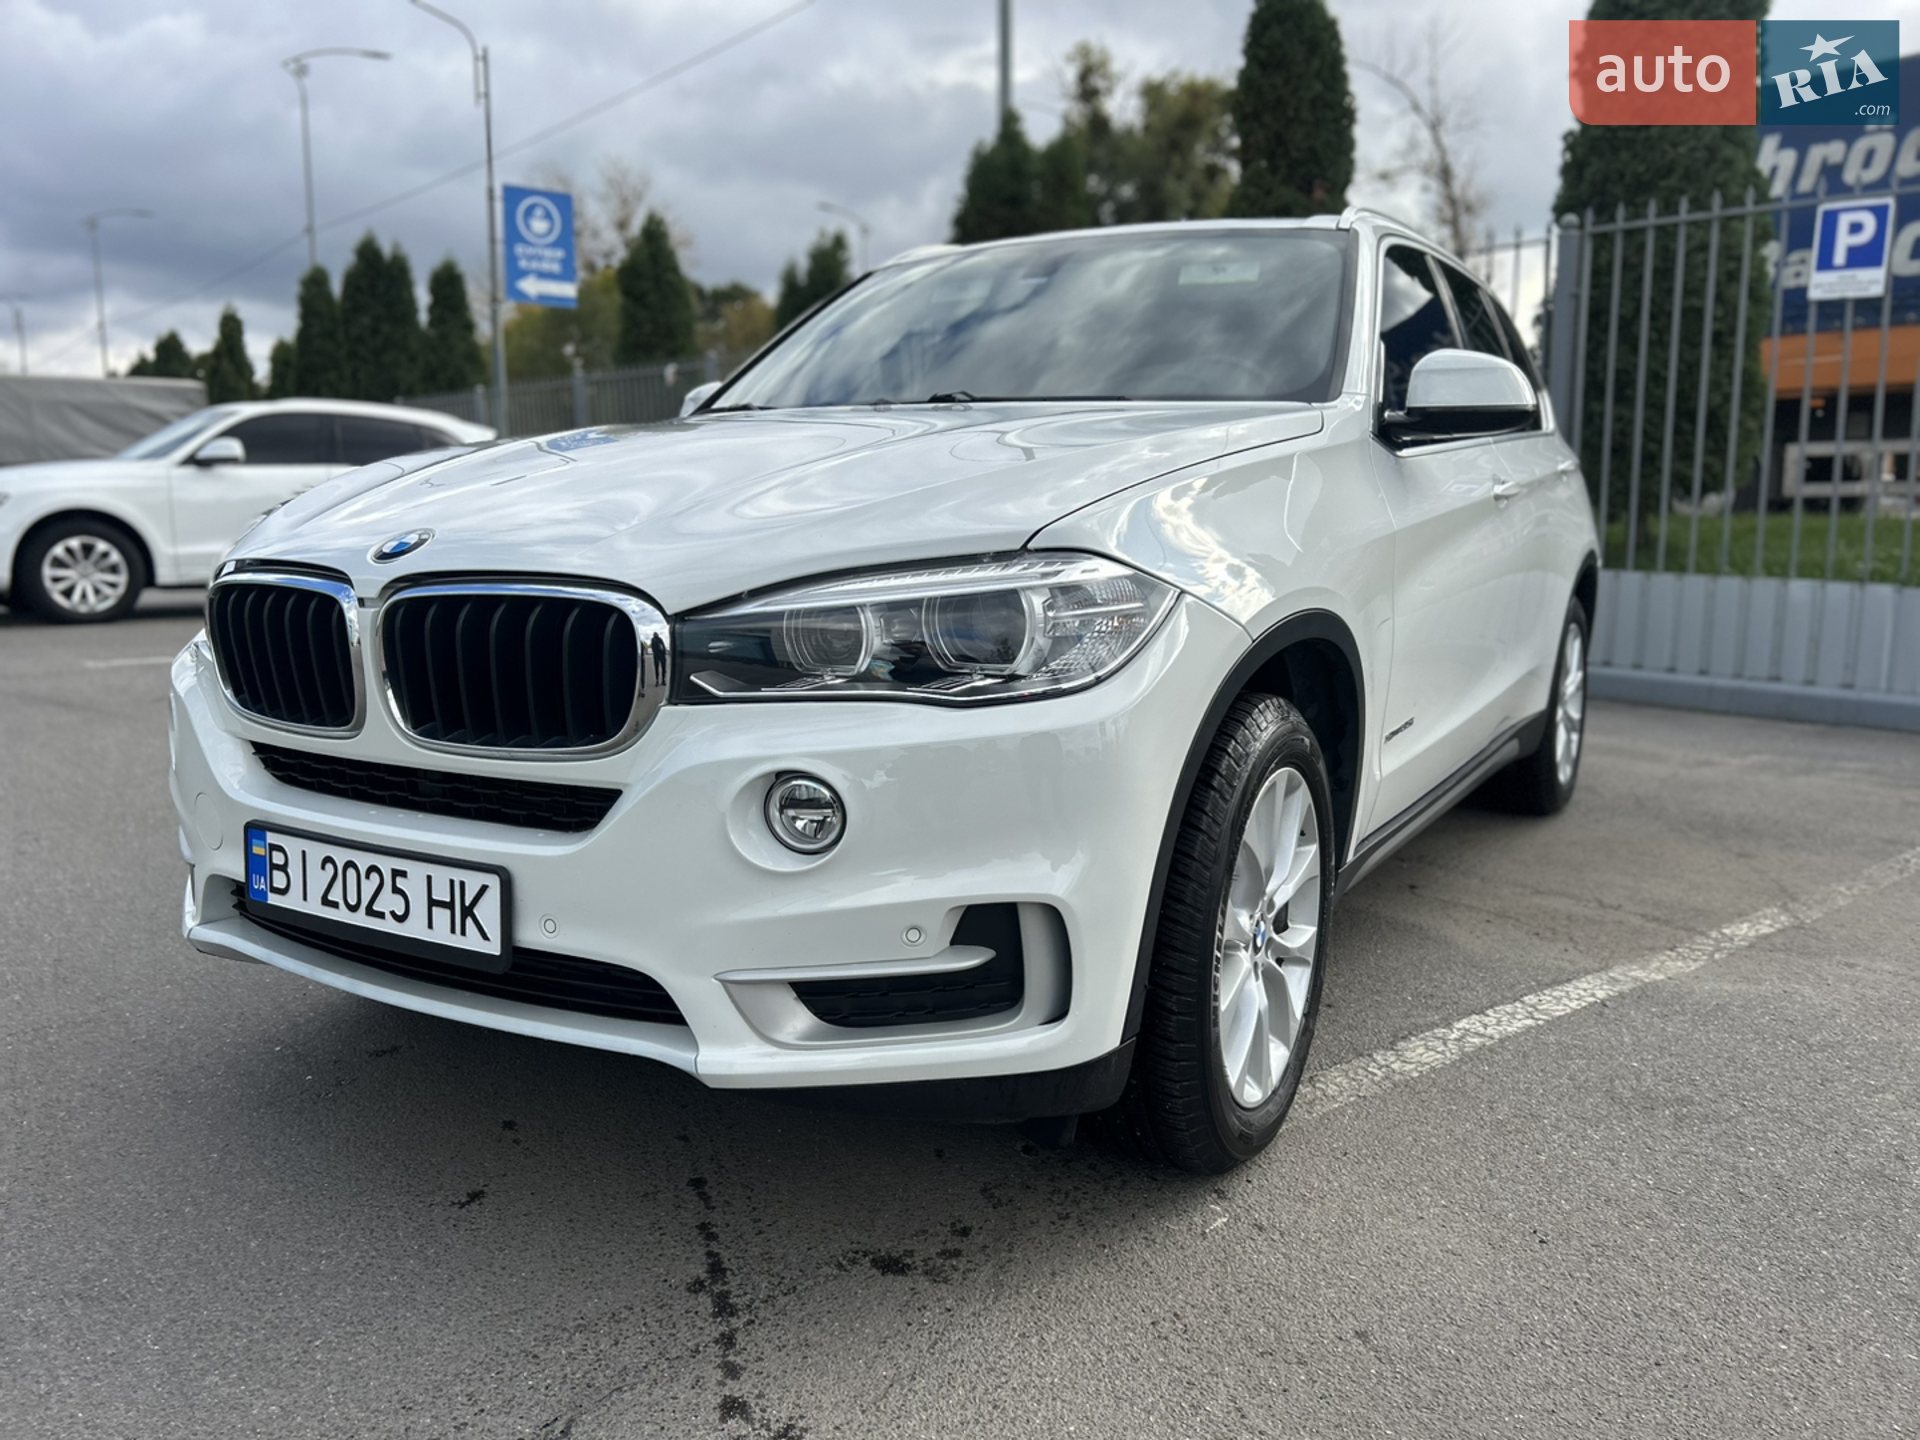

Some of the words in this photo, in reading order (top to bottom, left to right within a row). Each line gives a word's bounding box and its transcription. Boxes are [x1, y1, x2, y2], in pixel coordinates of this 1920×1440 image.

[1832, 209, 1877, 268] P
[252, 873, 267, 891] UA
[268, 842, 308, 902] BI
[320, 855, 410, 923] 2025
[426, 874, 491, 942] HK
